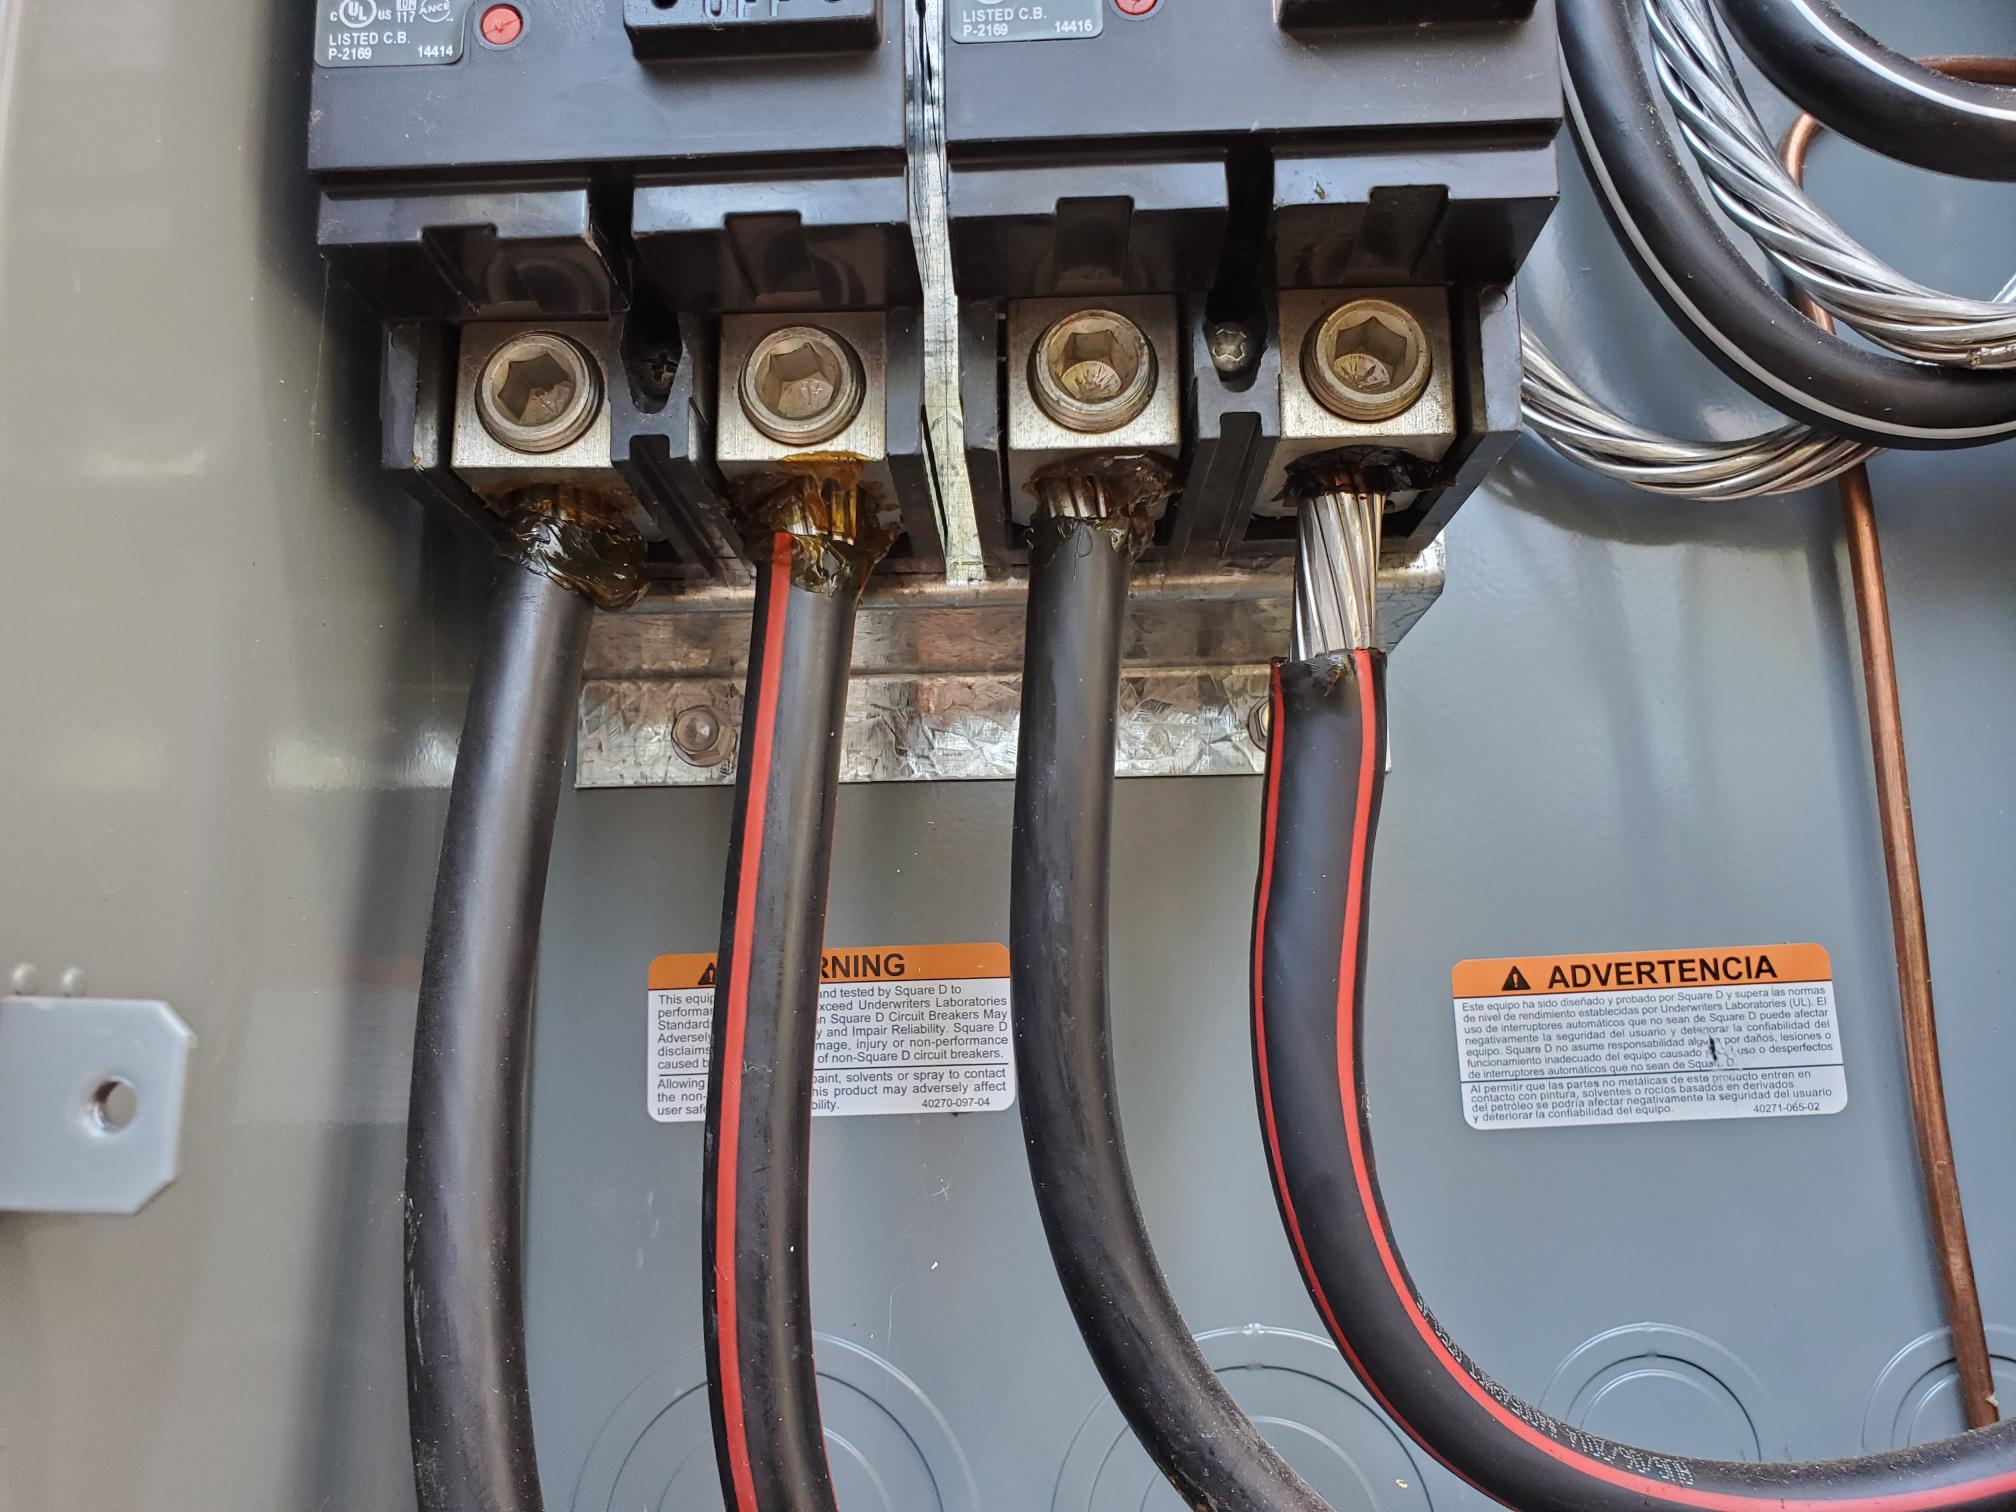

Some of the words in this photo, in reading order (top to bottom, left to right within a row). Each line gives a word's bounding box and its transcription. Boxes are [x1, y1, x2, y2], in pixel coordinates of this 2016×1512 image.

[397, 11, 416, 23] 117
[419, 2, 451, 14] ANCE
[963, 8, 1014, 23] LISTED
[1018, 6, 1047, 20] C.B.
[329, 32, 379, 46] LISTED
[383, 31, 411, 44] C.B.
[963, 23, 1008, 37] P-2169
[1054, 19, 1093, 33] 14416
[328, 47, 372, 60] P-2169
[418, 45, 453, 58] 14414
[1548, 955, 1778, 989] ADVERTENCIA
[658, 992, 682, 1003] This
[839, 986, 874, 997] tested
[877, 985, 891, 998] by
[894, 984, 935, 998] Square
[938, 984, 947, 994] D
[950, 984, 961, 994] to
[858, 997, 931, 1009] Underwriters
[935, 994, 1007, 1007] Laboratories
[1461, 1001, 1484, 1011] Este
[1486, 999, 1521, 1012] equipo
[1521, 998, 1535, 1008] ha
[1536, 997, 1558, 1007] sido
[1559, 995, 1605, 1006] diseñado
[1615, 993, 1657, 1006] probado
[1658, 994, 1676, 1004] por
[1676, 990, 1713, 1003] Square
[1714, 990, 1724, 999] D
[1734, 990, 1769, 1001] supera
[1770, 987, 1786, 997] las
[1787, 988, 1826, 996] normas
[830, 1012, 871, 1026] Square
[875, 1011, 884, 1022] D
[888, 1010, 925, 1021] Circuit
[928, 1008, 979, 1020] Breakers
[983, 1007, 1007, 1021] May
[1462, 1012, 1476, 1022] de
[1477, 1011, 1501, 1021] nivel
[1502, 1010, 1517, 1020] de
[1518, 1008, 1576, 1019] rendimiento
[1577, 1005, 1639, 1016] establecidas
[1641, 1006, 1658, 1016] por
[1660, 1001, 1723, 1013] Underwriters
[1724, 998, 1787, 1010] Laboratories
[1815, 996, 1827, 1006] El
[826, 1026, 847, 1037] and
[852, 1024, 888, 1038] Impair
[891, 1022, 949, 1037] Reliability.
[952, 1021, 994, 1035] Square
[998, 1021, 1007, 1031] D
[1484, 1022, 1498, 1032] de
[1500, 1019, 1563, 1033] interruptores
[1565, 1016, 1625, 1028] automáticos
[1627, 1018, 1647, 1028] que
[1665, 1016, 1690, 1024] sean
[1692, 1013, 1706, 1022] de
[1708, 1011, 1745, 1024] Square
[1747, 1010, 1757, 1020] D
[1758, 1009, 1792, 1021] puede
[1793, 1007, 1828, 1018] afectar
[1464, 1032, 1539, 1046] negativamente
[1542, 1031, 1552, 1041] la
[1555, 1029, 1607, 1042] seguridad
[1608, 1028, 1625, 1037] del
[1628, 1026, 1666, 1037] usuario
[1732, 1022, 1742, 1032] la
[1745, 1019, 1810, 1031] confiabilidad
[1813, 1018, 1830, 1028] del
[657, 1044, 710, 1056] disclaims
[856, 1037, 887, 1051] injury
[909, 1033, 1008, 1049] non-performance
[1504, 1043, 1541, 1056] Square
[1543, 1042, 1553, 1052] D
[1570, 1042, 1605, 1051] asume
[1607, 1036, 1685, 1051] responsabilidad
[1723, 1036, 1741, 1045] por
[1779, 1030, 1822, 1040] lesiones
[657, 1057, 698, 1069] caused
[817, 1052, 828, 1063] of
[831, 1050, 898, 1065] non-Square
[901, 1050, 912, 1060] D
[913, 1048, 947, 1060] circuit
[950, 1047, 1003, 1058] breakers.
[1466, 1054, 1542, 1067] funcionamiento
[1544, 1051, 1602, 1063] inadecuado
[1603, 1051, 1620, 1060] del
[1622, 1049, 1657, 1062] equipo
[1659, 1047, 1702, 1058] causado
[1767, 1041, 1834, 1055] desperfectos
[657, 1077, 705, 1091] Allowing
[845, 1070, 893, 1082] solvents
[897, 1072, 909, 1080] or
[913, 1071, 944, 1082] spray
[948, 1069, 960, 1078] to
[963, 1067, 1006, 1078] contact
[1467, 1068, 1481, 1078] de
[1482, 1066, 1545, 1080] interruptores
[1546, 1063, 1607, 1075] automáticos
[1608, 1064, 1628, 1074] que
[1630, 1063, 1643, 1071] no
[1645, 1062, 1670, 1070] sean
[1671, 1059, 1685, 1069] de
[657, 1091, 675, 1102] the
[833, 1084, 877, 1098] product
[882, 1086, 907, 1096] may
[912, 1081, 968, 1095] adversely
[973, 1080, 1006, 1091] affect
[1469, 1084, 1481, 1093] Al
[1483, 1082, 1524, 1094] permitir
[1525, 1083, 1546, 1092] que
[1547, 1080, 1564, 1089] las
[1566, 1079, 1600, 1091] partes
[1617, 1075, 1668, 1086] metálicas
[1669, 1074, 1684, 1083] de
[1685, 1074, 1709, 1083] este
[1759, 1070, 1794, 1079] entren
[1797, 1070, 1811, 1078] en
[1470, 1092, 1515, 1102] contacto
[1517, 1092, 1537, 1100] con
[1539, 1088, 1579, 1101] pintura,
[1581, 1086, 1632, 1097] solventes
[1678, 1081, 1723, 1092] basados
[1741, 1078, 1794, 1089] derivados
[921, 1097, 990, 1108] 40270-097-04
[1471, 1102, 1488, 1111] del
[1587, 1095, 1624, 1106] afectar
[1625, 1092, 1704, 1106] negativamente
[1705, 1091, 1716, 1100] la
[1717, 1089, 1771, 1102] seguridad
[1772, 1088, 1790, 1097] del
[1791, 1086, 1832, 1096] usuario
[1752, 1101, 1820, 1113] 40271-065-02
[657, 1107, 683, 1115] user
[1481, 1109, 1534, 1120] deteriorar
[1535, 1108, 1545, 1118] la
[1547, 1105, 1613, 1117] confiabilidad
[1615, 1104, 1632, 1114] del
